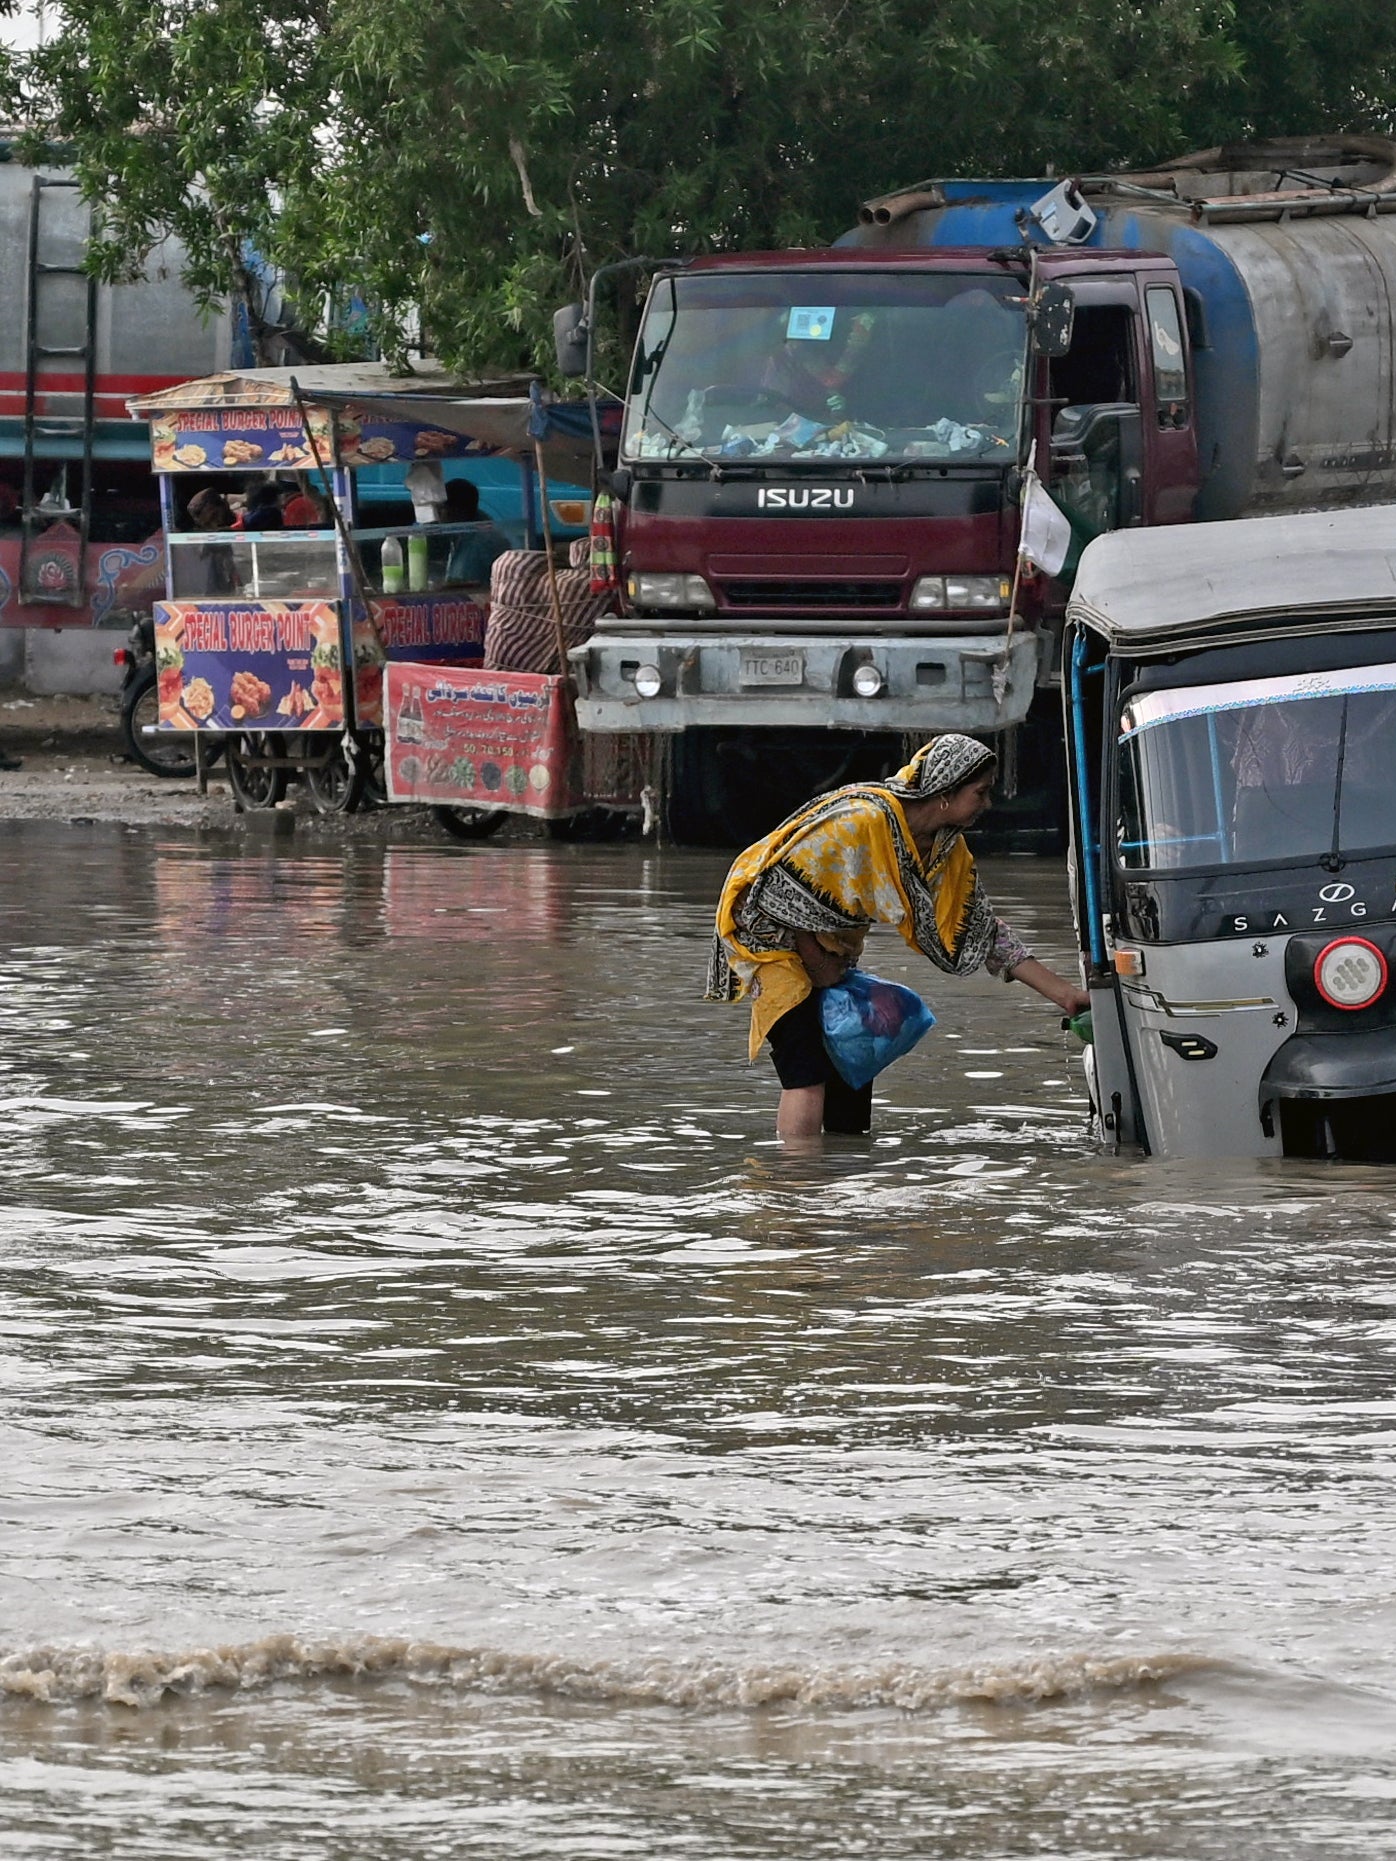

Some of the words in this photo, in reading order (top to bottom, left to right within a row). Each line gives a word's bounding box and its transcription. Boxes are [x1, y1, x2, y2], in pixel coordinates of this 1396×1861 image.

[176, 412, 219, 433] SPECIAL
[221, 410, 267, 432] BURGER
[269, 409, 304, 430] POINT
[758, 488, 854, 508] ISUZU
[183, 612, 228, 652] SPECIAL
[229, 611, 275, 654] BURGER
[277, 611, 311, 651] POINT
[383, 604, 429, 648] SPECIAL
[432, 602, 482, 646] BURGER
